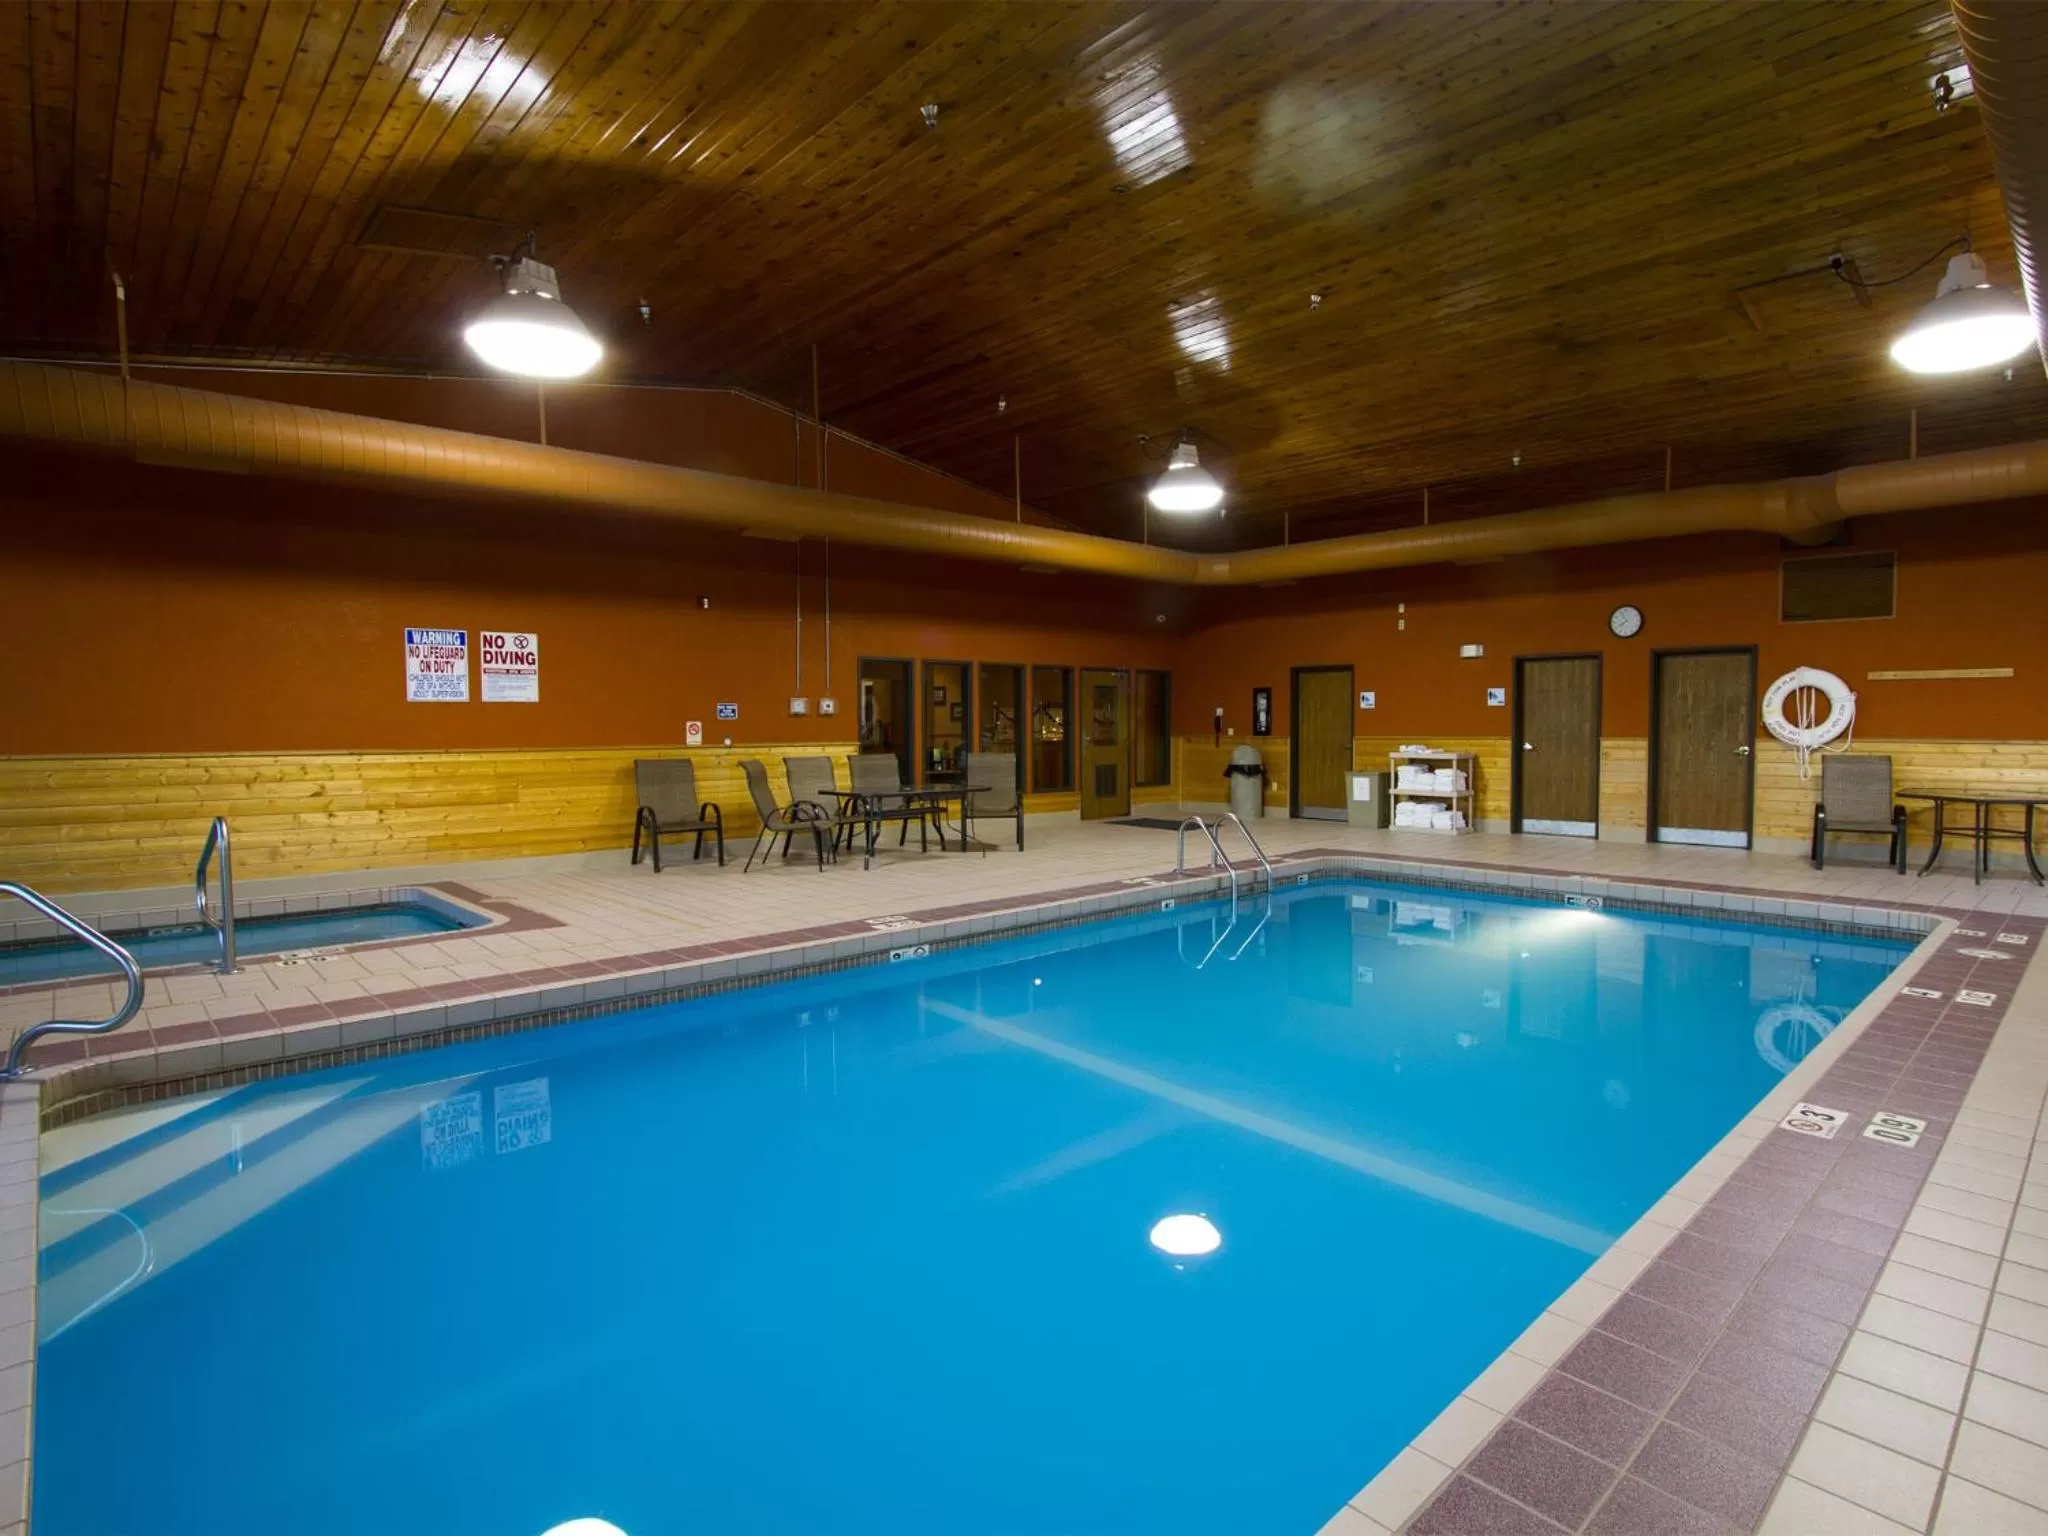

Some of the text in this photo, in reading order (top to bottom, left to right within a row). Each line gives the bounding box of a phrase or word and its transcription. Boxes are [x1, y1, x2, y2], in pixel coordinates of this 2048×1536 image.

[412, 630, 460, 645] WARNING
[483, 634, 505, 649] NO
[409, 646, 465, 660] NO LIFEGUARD
[483, 650, 536, 666] DIVING
[420, 660, 455, 674] ON DUTY
